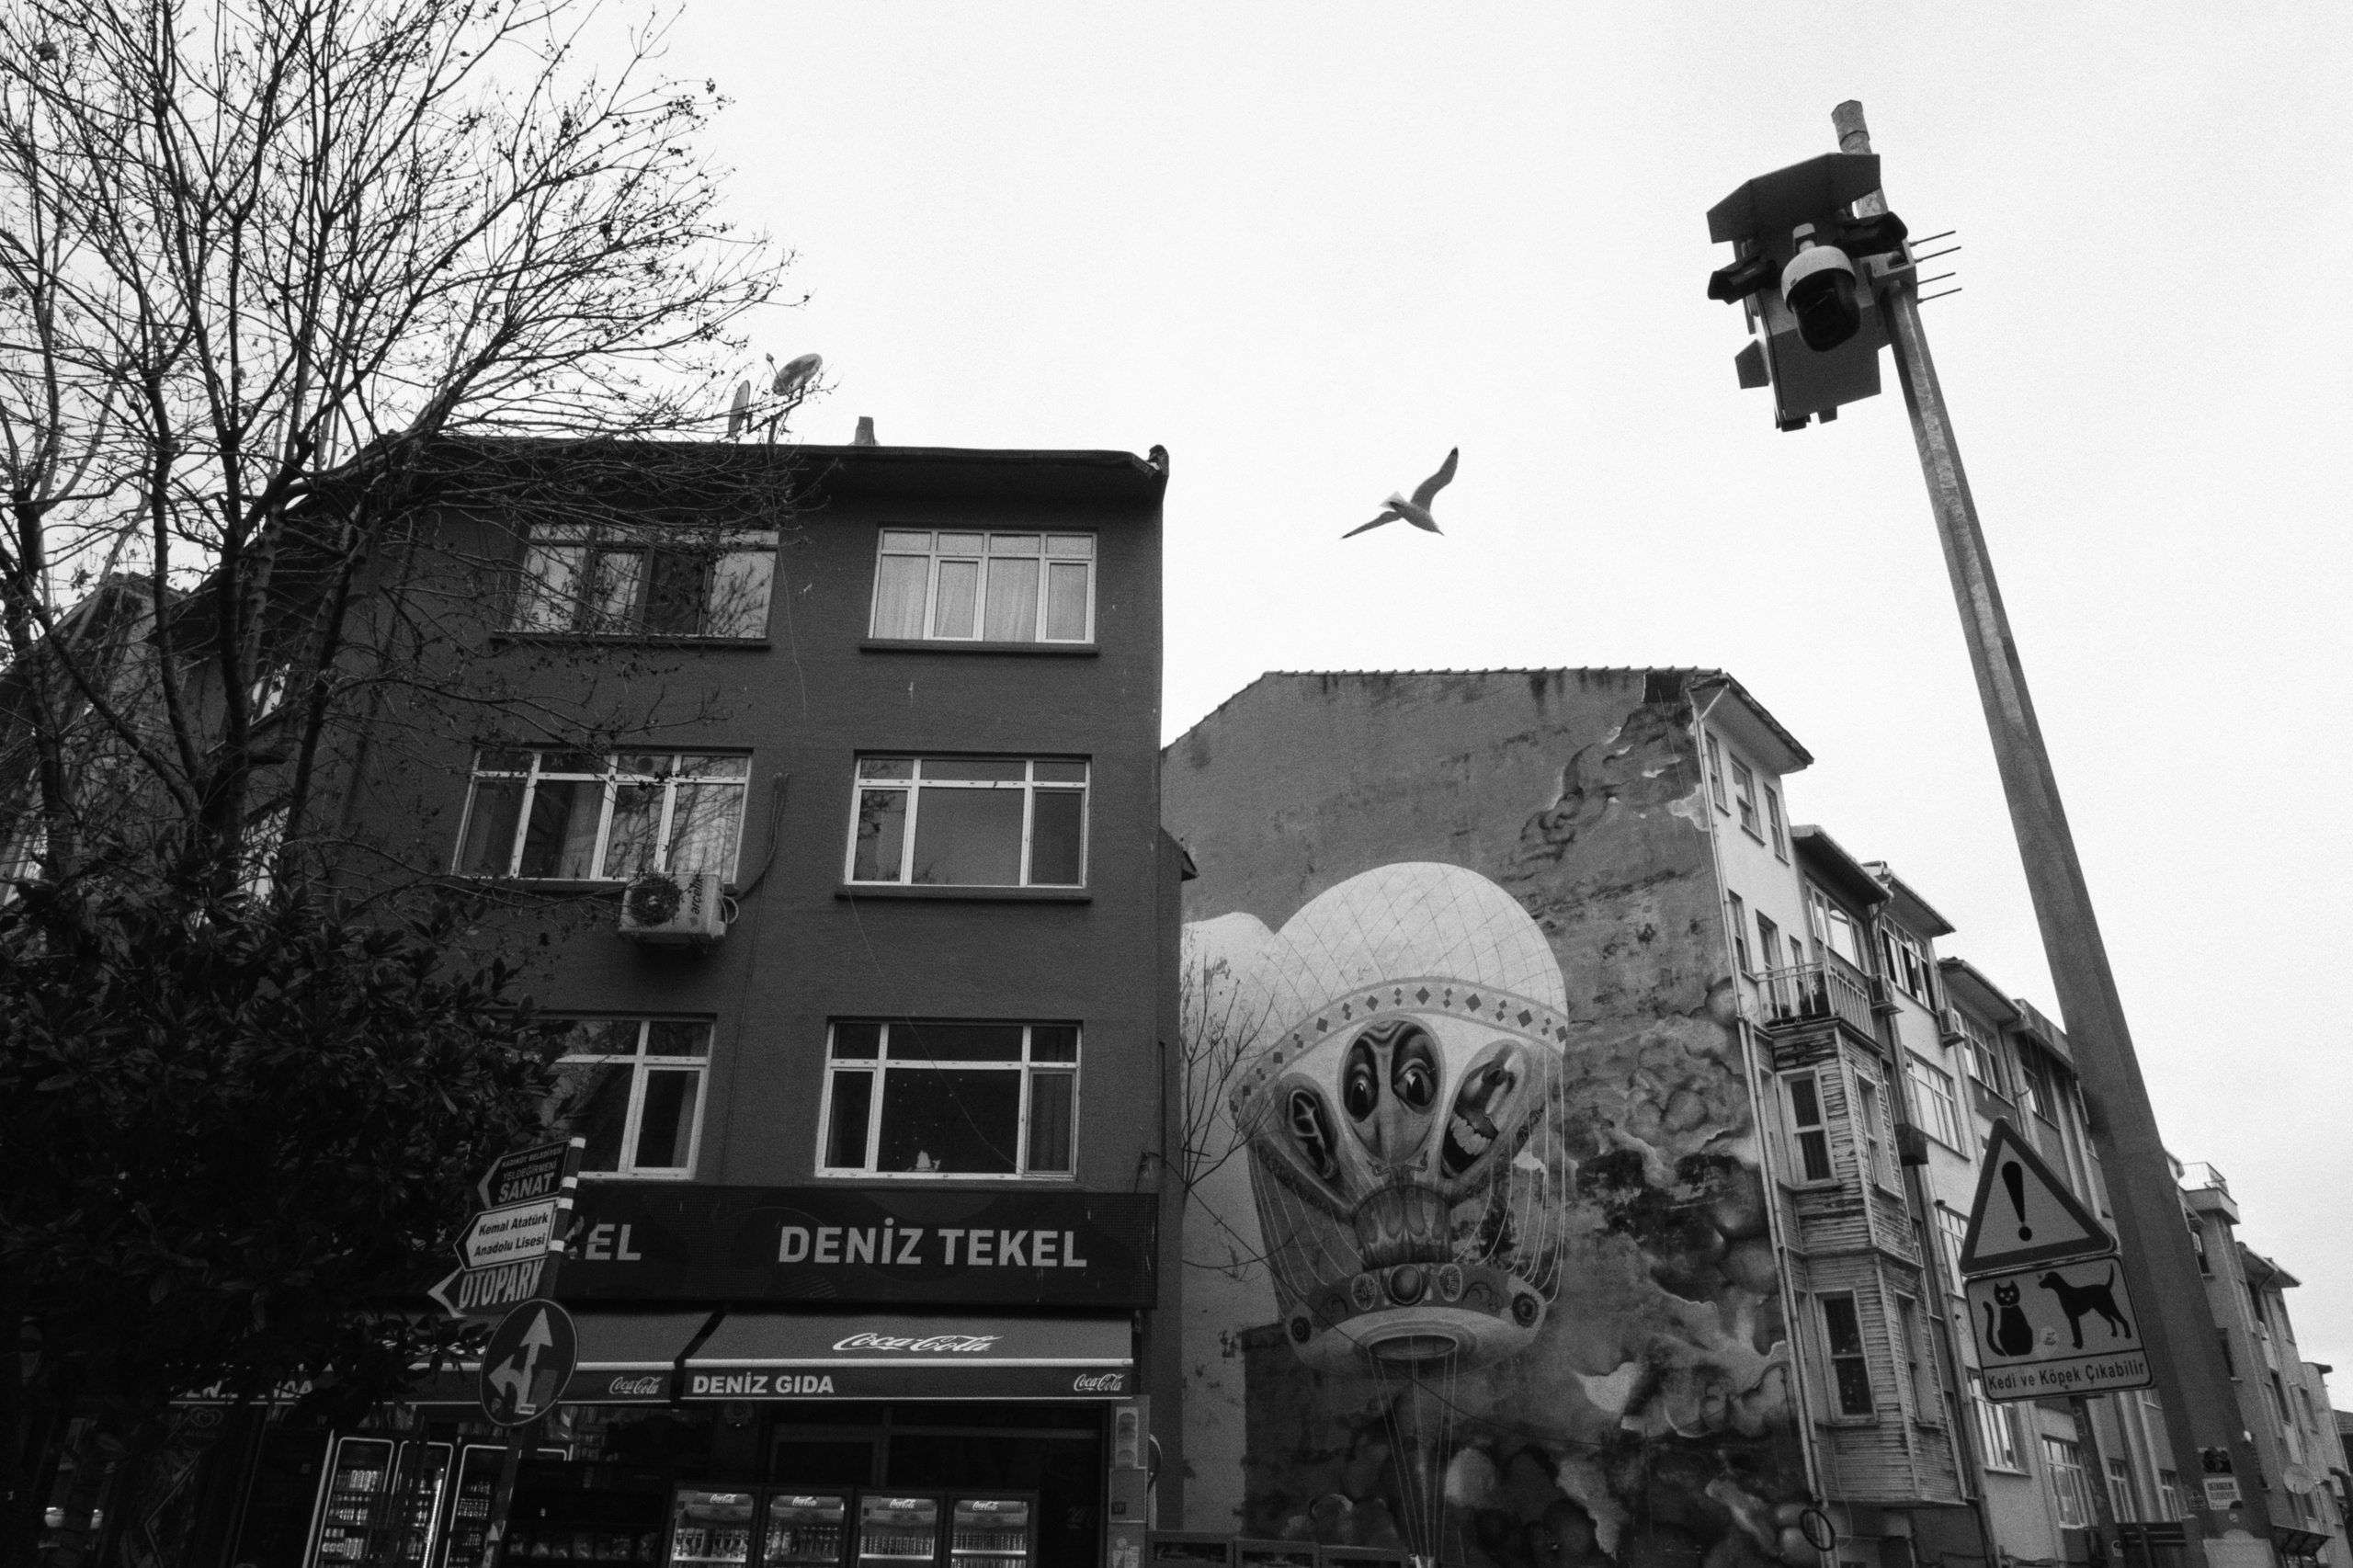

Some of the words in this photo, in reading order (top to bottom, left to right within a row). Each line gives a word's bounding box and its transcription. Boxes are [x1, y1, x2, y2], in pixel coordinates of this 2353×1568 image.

[501, 1155, 528, 1168] KADIKÖY
[529, 1144, 563, 1162] BELEDİYESİ
[503, 1157, 558, 1182] YELDEĞİRMENİ
[498, 1172, 555, 1203] SANAT
[478, 1220, 509, 1236] Kemal
[511, 1211, 549, 1230] Atatürk
[473, 1240, 513, 1257] Anadolu
[516, 1233, 546, 1250] Lisesi
[778, 1216, 923, 1265] DENİZ
[938, 1228, 1087, 1267] TEKEL
[459, 1259, 546, 1310] OTOPARK
[832, 1332, 1004, 1353] Coca-Cola
[692, 1371, 768, 1394] DENİZ
[775, 1375, 835, 1394] GIDA
[1987, 1373, 2017, 1391] Kedi
[2019, 1374, 2035, 1387] ve
[2039, 1366, 2081, 1388] Köpek
[2086, 1359, 2144, 1384] Çıkabilir
